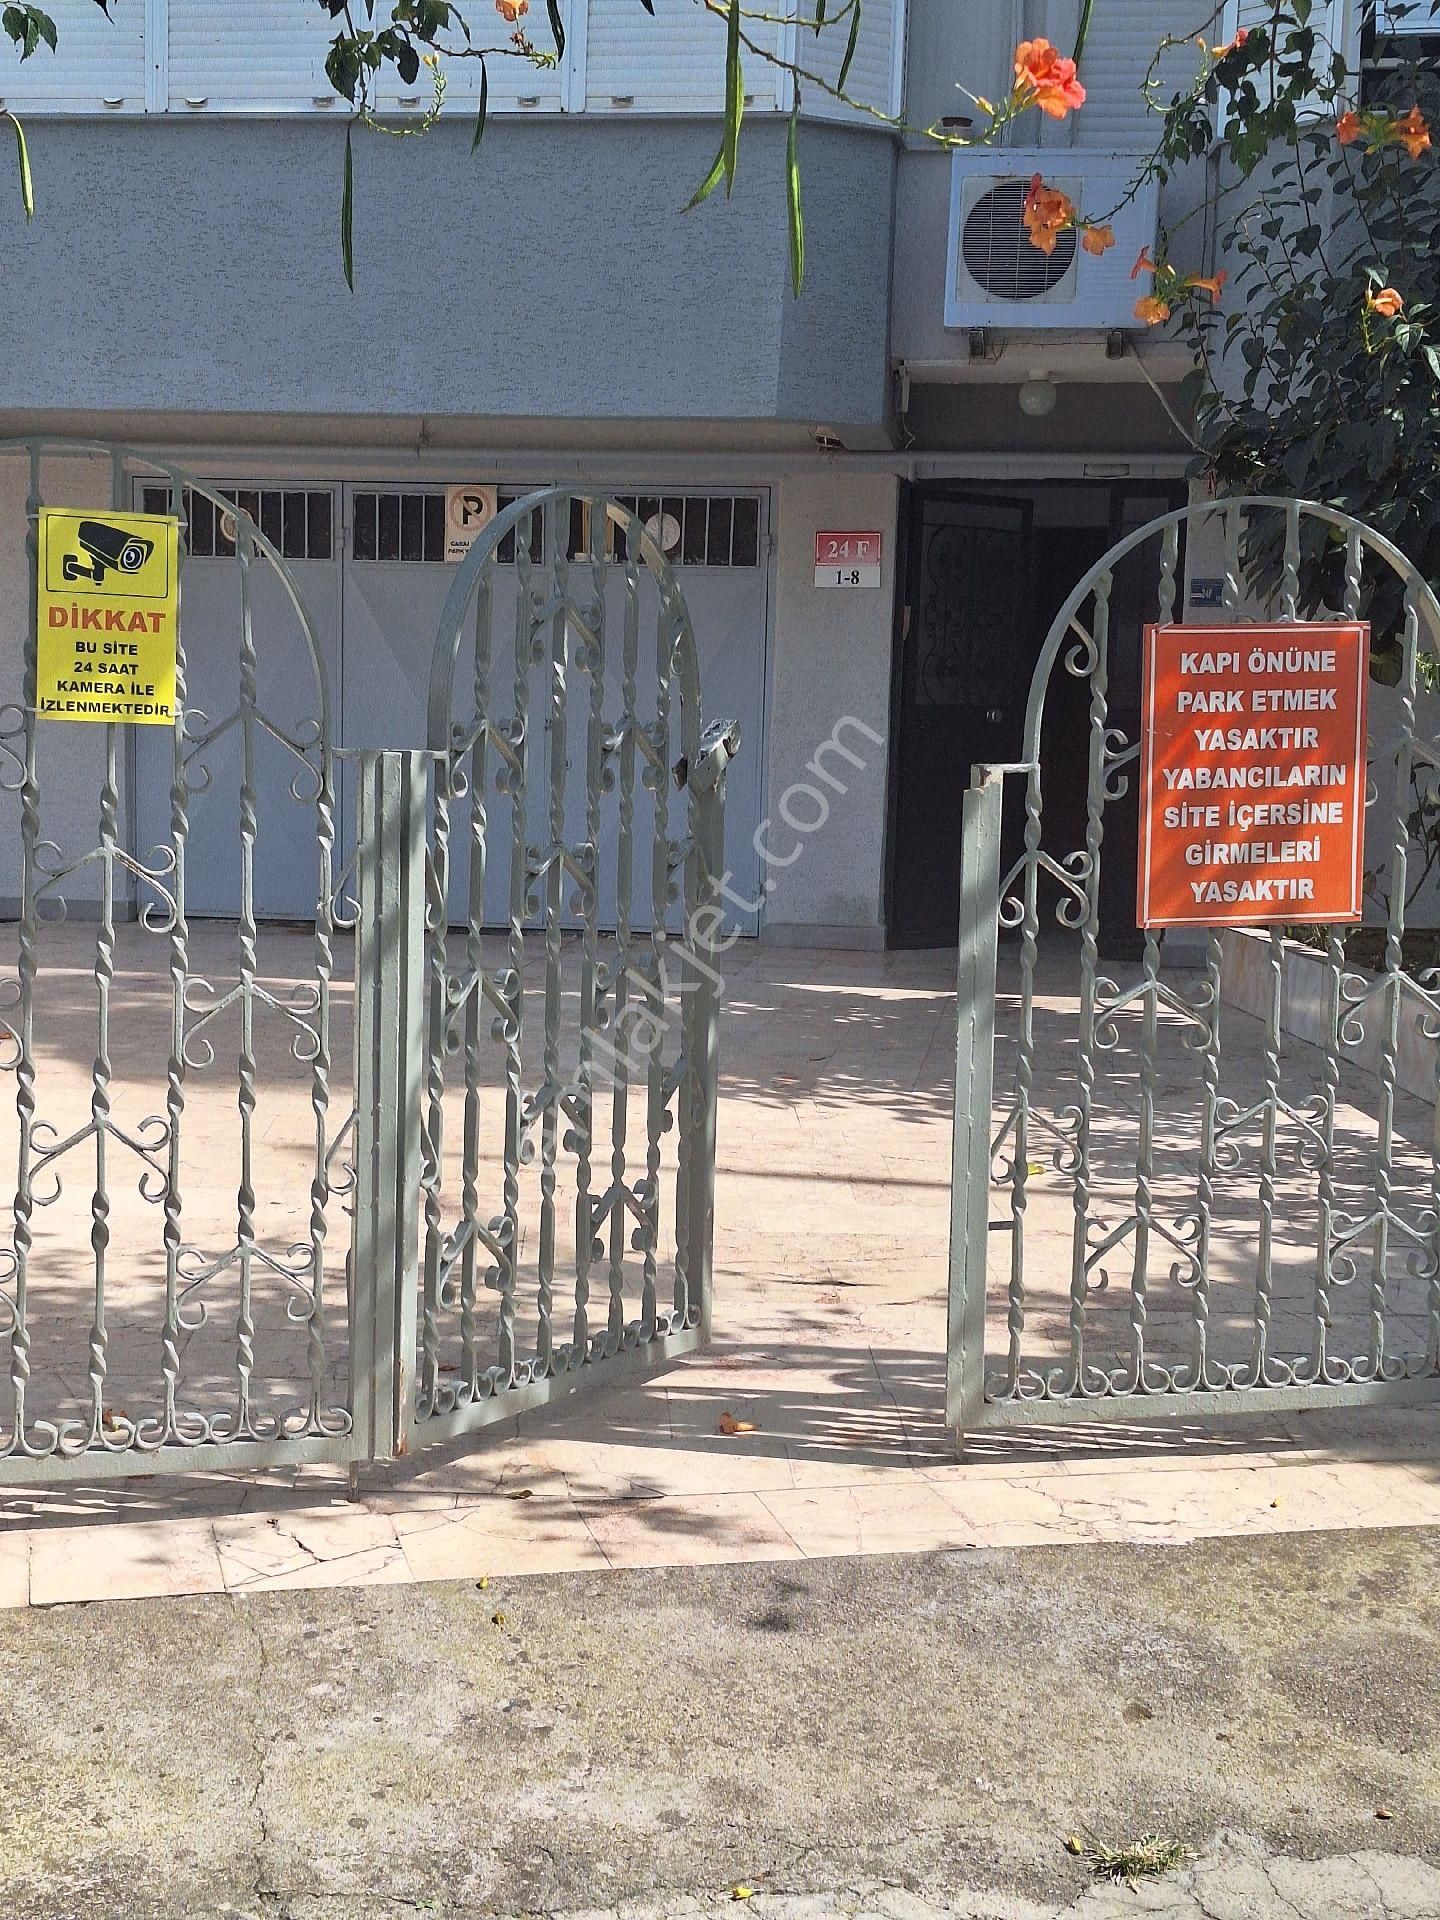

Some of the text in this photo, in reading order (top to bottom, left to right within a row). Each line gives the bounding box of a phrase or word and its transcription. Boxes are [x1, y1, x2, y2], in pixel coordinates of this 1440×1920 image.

[828, 541, 869, 558] 24 F
[836, 569, 859, 585] 1-8
[48, 602, 167, 634] DİKKAT
[75, 640, 138, 656] BU SİTE
[74, 661, 139, 675] 24 SAAT
[1180, 647, 1336, 674] KAPI ÖNÜNE
[57, 680, 155, 696] KAMERA İLE
[40, 697, 169, 716] İZLENMEKTEDİR
[1177, 688, 1337, 713] PARK ETMEK
[1194, 727, 1319, 751] YASAKTIR
[1162, 764, 1346, 790] YABANCILARIN
[1163, 798, 1344, 832] SİTE İÇERSİNE
[1185, 836, 1321, 866] GİRMELERİ
[1190, 879, 1314, 903] YASAKTIR
